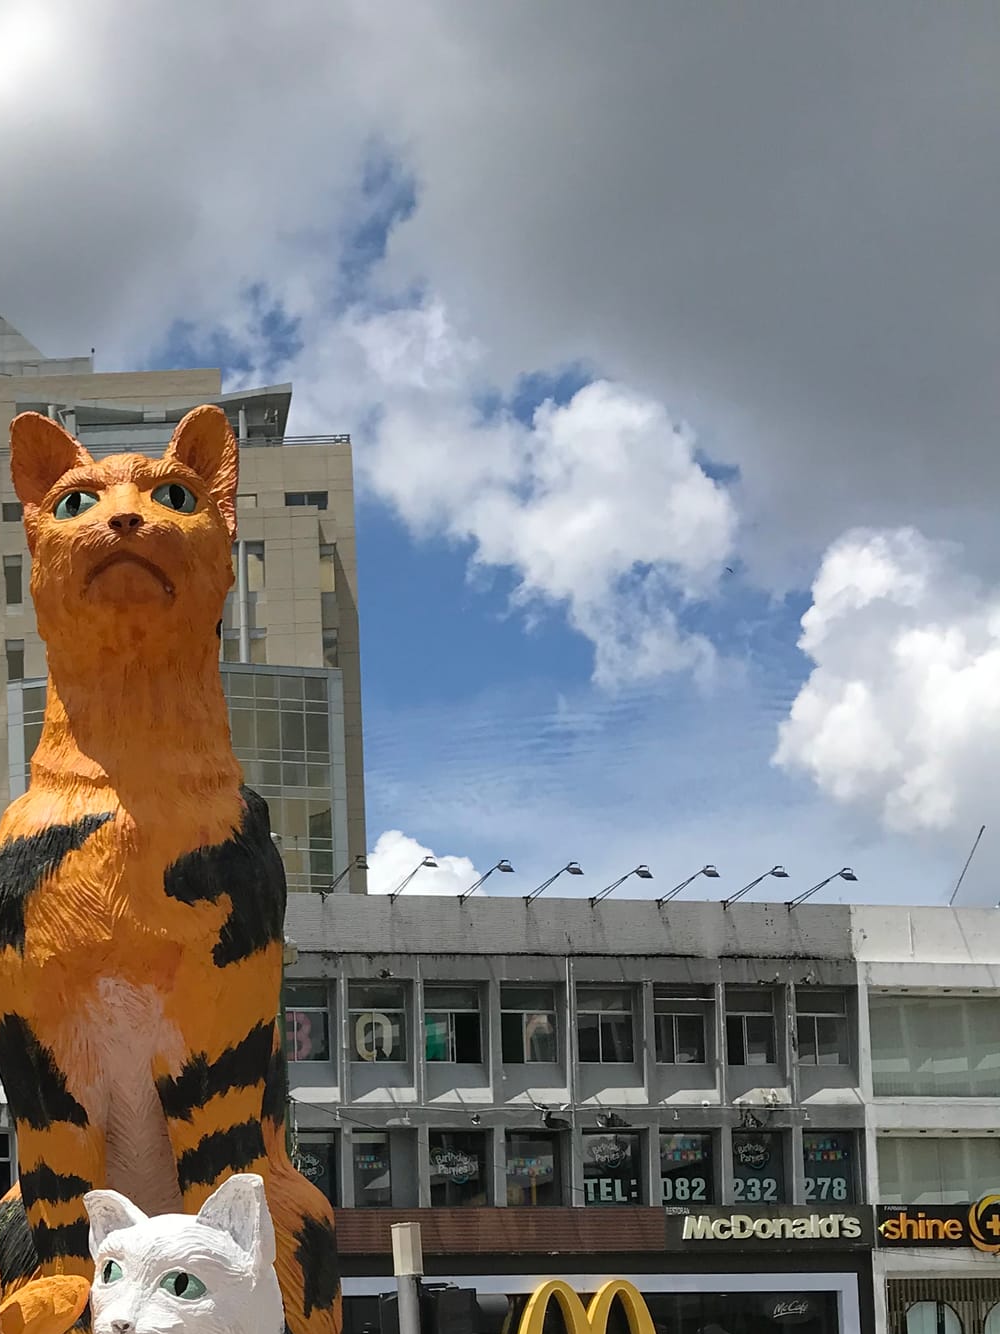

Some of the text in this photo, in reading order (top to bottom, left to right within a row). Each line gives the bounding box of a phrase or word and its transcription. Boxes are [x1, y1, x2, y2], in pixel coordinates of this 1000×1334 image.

[584, 1177, 847, 1201] TEL: 082 232 278
[682, 1213, 862, 1240] McDonald's
[883, 1212, 964, 1240] shine
